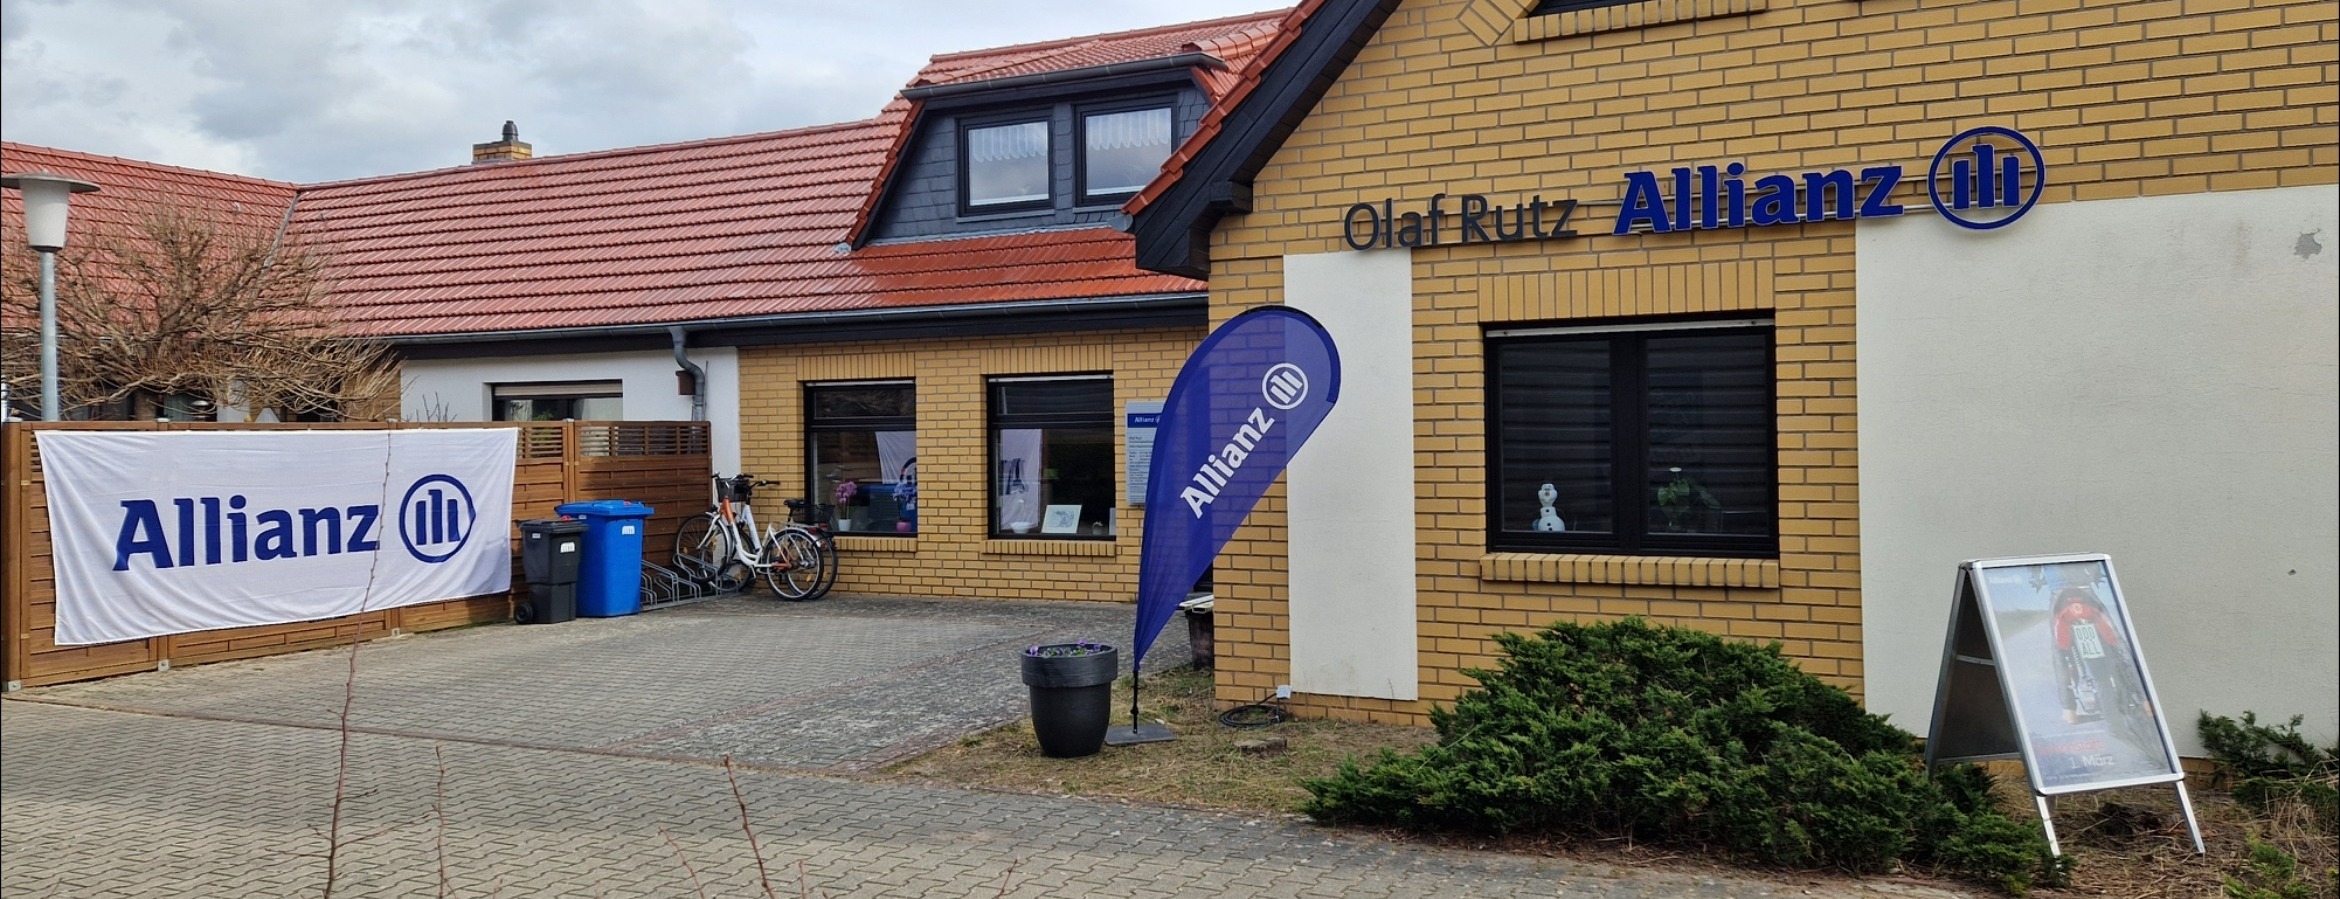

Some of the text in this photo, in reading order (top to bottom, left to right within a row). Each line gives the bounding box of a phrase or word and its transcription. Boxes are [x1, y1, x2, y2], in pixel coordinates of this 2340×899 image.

[1344, 194, 1578, 251] Olaf Rutz
[1613, 162, 1904, 235] Allianz
[1180, 407, 1275, 519] Allianz
[113, 495, 380, 572] Allianz
